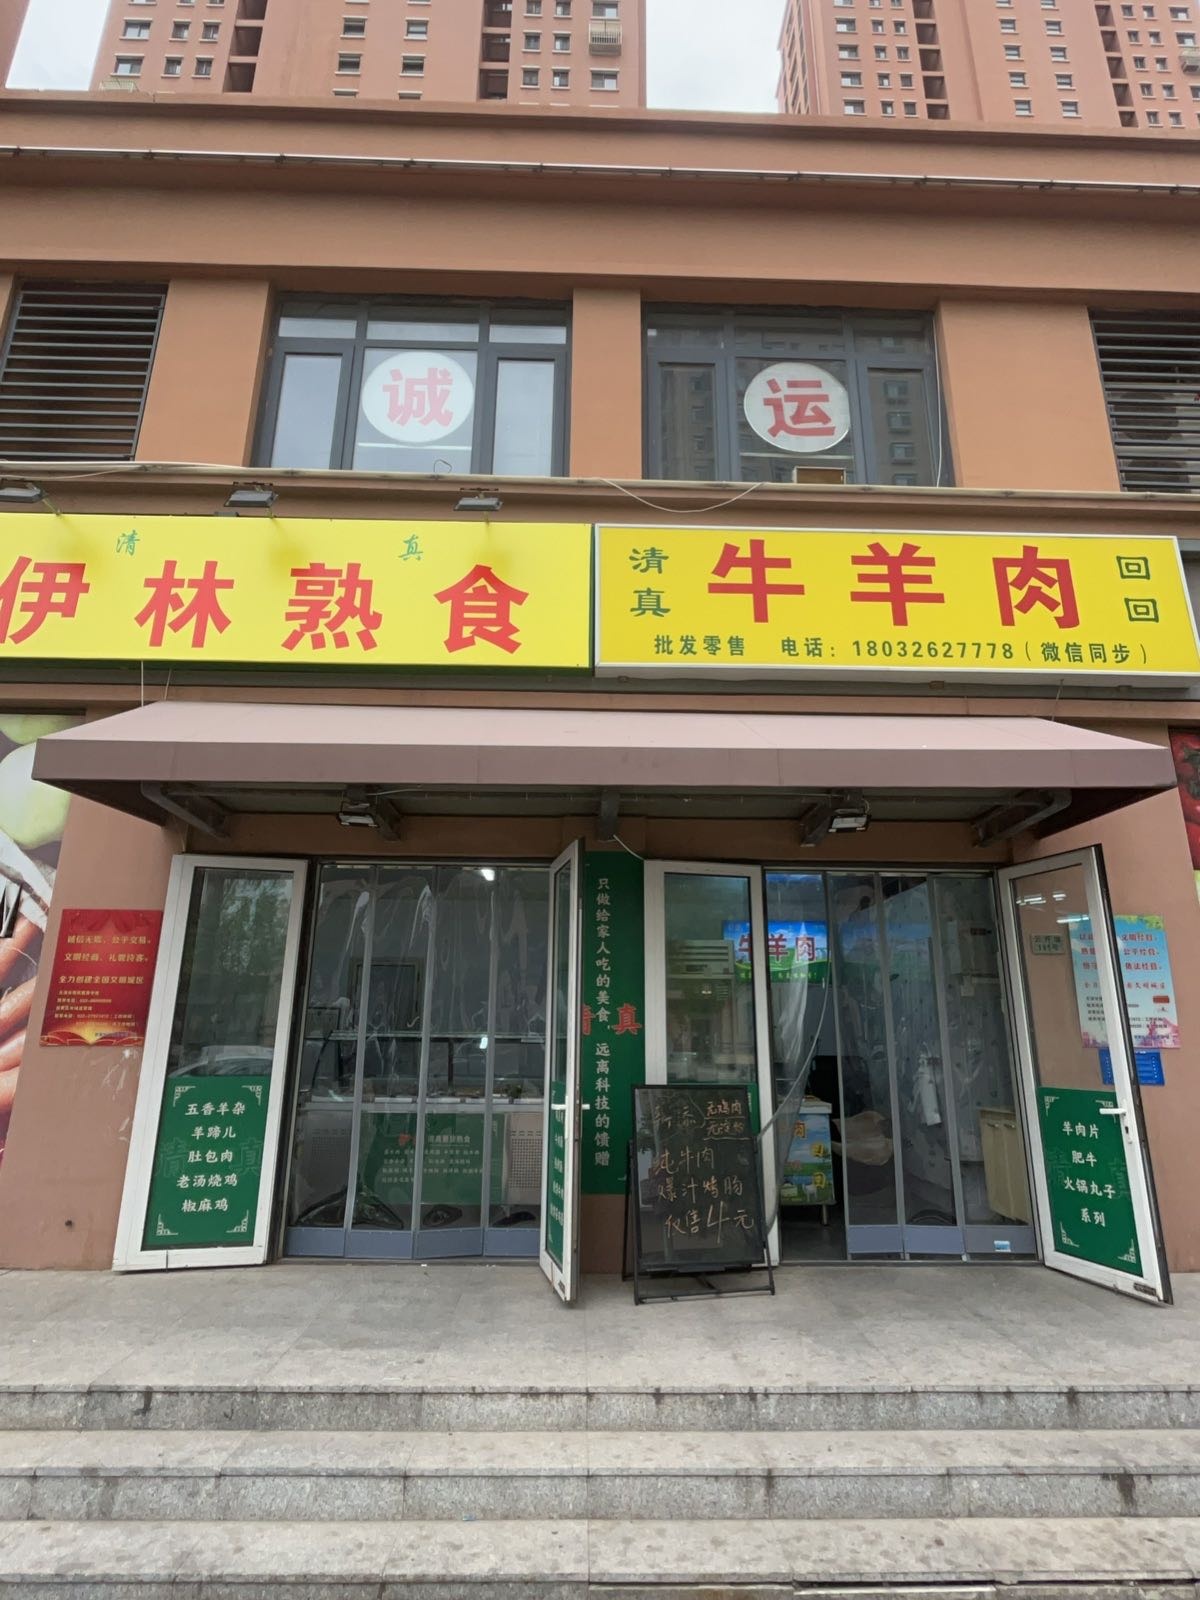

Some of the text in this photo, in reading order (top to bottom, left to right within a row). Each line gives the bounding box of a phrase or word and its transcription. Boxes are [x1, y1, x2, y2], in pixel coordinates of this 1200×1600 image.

[382, 368, 453, 428] 诚
[763, 378, 836, 438] 运
[115, 530, 424, 562] 清 真
[629, 547, 671, 618] 清真
[707, 538, 1080, 629] 牛羊肉
[1116, 555, 1160, 623] 回回
[0, 555, 529, 654] 伊林熟食
[654, 634, 746, 657] 批发零售
[185, 1102, 246, 1116] 五香羊杂
[191, 1126, 236, 1140] 羊蹄儿
[1062, 1121, 1099, 1139] 羊肉片
[187, 1149, 233, 1164] 肚包肉
[1072, 1150, 1097, 1167] 肥牛
[176, 1173, 238, 1189] 老汤烧鸡
[1064, 1176, 1116, 1199] 火锅丸子
[181, 1198, 229, 1213] 椒麻鸡
[1080, 1207, 1106, 1228] 系列
